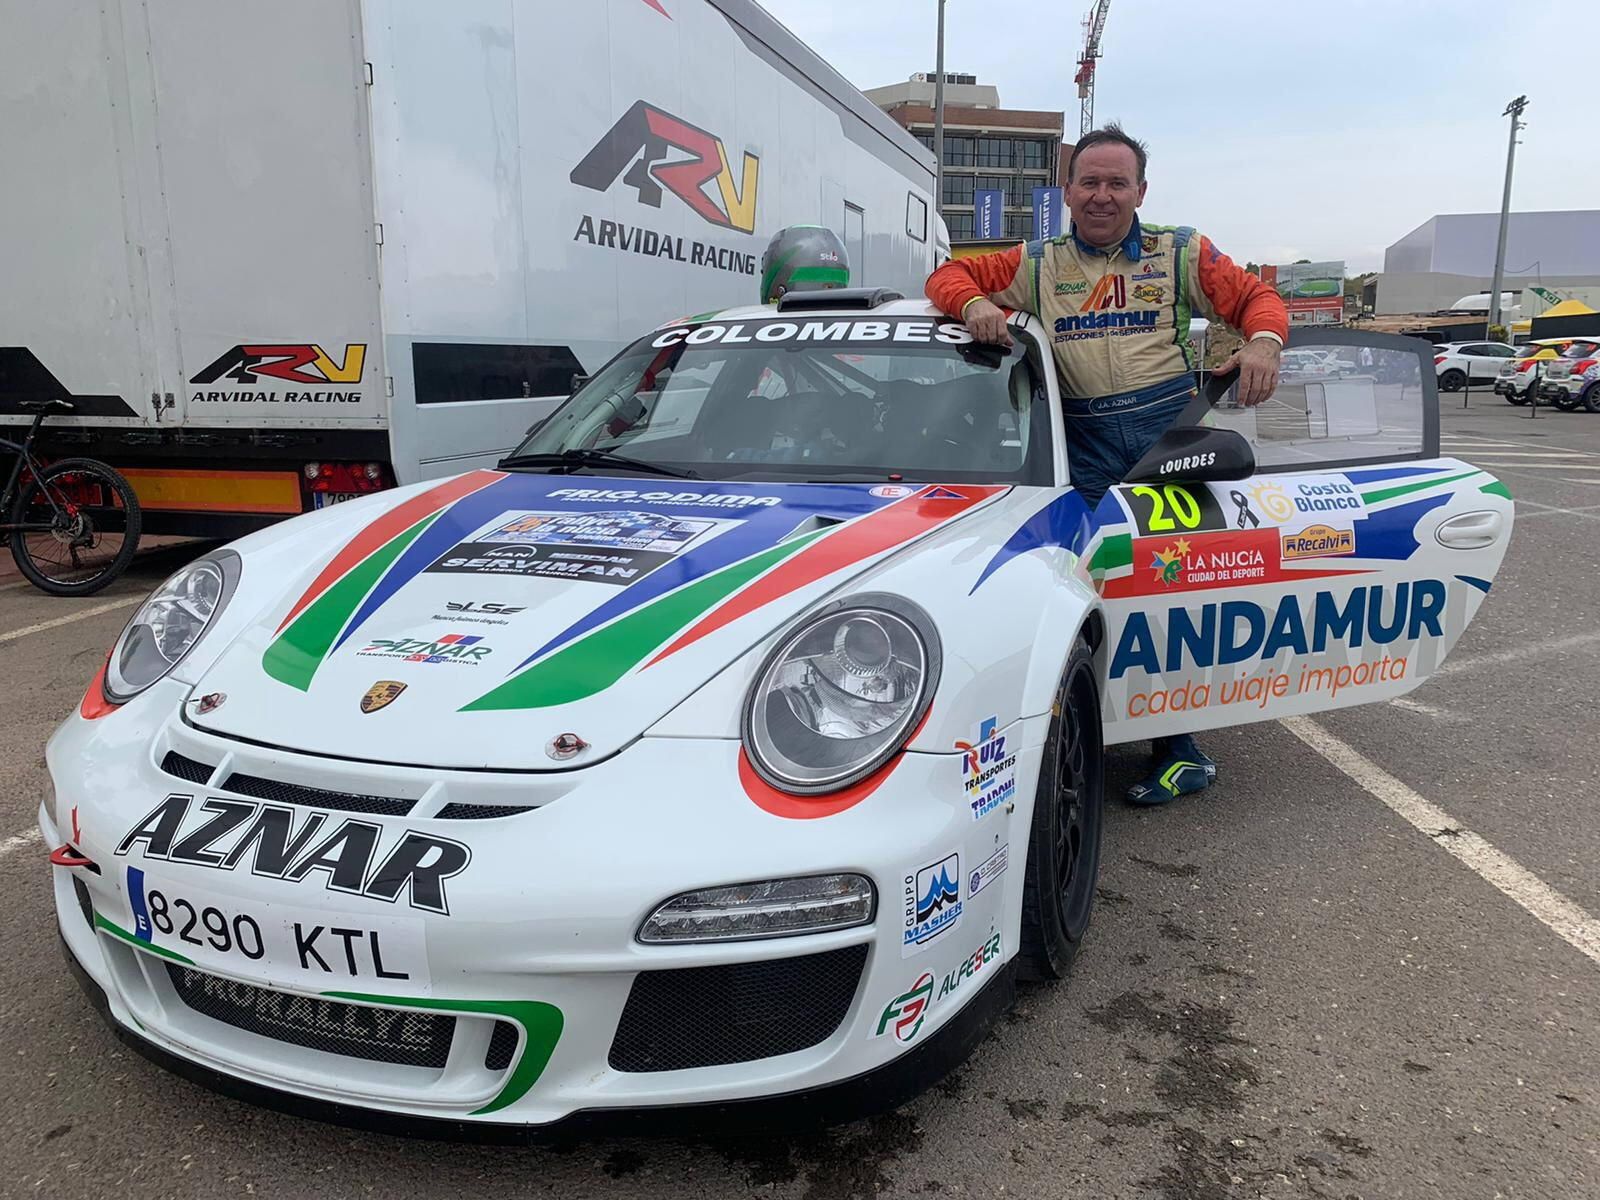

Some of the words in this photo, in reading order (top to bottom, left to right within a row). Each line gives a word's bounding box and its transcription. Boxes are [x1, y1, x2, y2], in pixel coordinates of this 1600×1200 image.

[573, 214, 687, 262] ARVIDAL
[690, 241, 756, 276] RACING
[1054, 310, 1160, 333] andamur
[651, 321, 975, 348] COLOMBES
[1055, 331, 1105, 344] ESTACIONES
[1119, 326, 1157, 337] SERVICIO
[191, 392, 280, 402] ARVIDAL
[284, 392, 362, 402] RACING
[1111, 396, 1137, 408] AZNAR
[1160, 452, 1216, 474] LOURDES
[546, 488, 782, 506] FRIGODIMA
[1297, 482, 1354, 496] Costa
[1131, 484, 1201, 531] 20
[1294, 496, 1360, 512] Blanca
[1297, 534, 1340, 552] Recalvi
[442, 557, 639, 578] SERVIMAN
[1187, 554, 1206, 570] LA
[1187, 571, 1215, 583] CIUDAD
[1217, 569, 1231, 580] DEL
[1232, 567, 1265, 579] DEPORTE
[1108, 579, 1447, 679] ANDAMUR
[371, 638, 492, 660] AZNAR
[1127, 680, 1211, 719] cada
[1220, 672, 1288, 709] viaje
[1297, 654, 1408, 698] importa
[965, 755, 1016, 791] TRANSPORTES
[114, 793, 472, 917] AZNAR
[905, 875, 914, 926] GRUPO
[137, 914, 147, 931] E
[904, 901, 962, 939] MASHER
[148, 889, 265, 960] 8290
[294, 922, 410, 980] KTL
[937, 933, 1001, 1001] ALFESER
